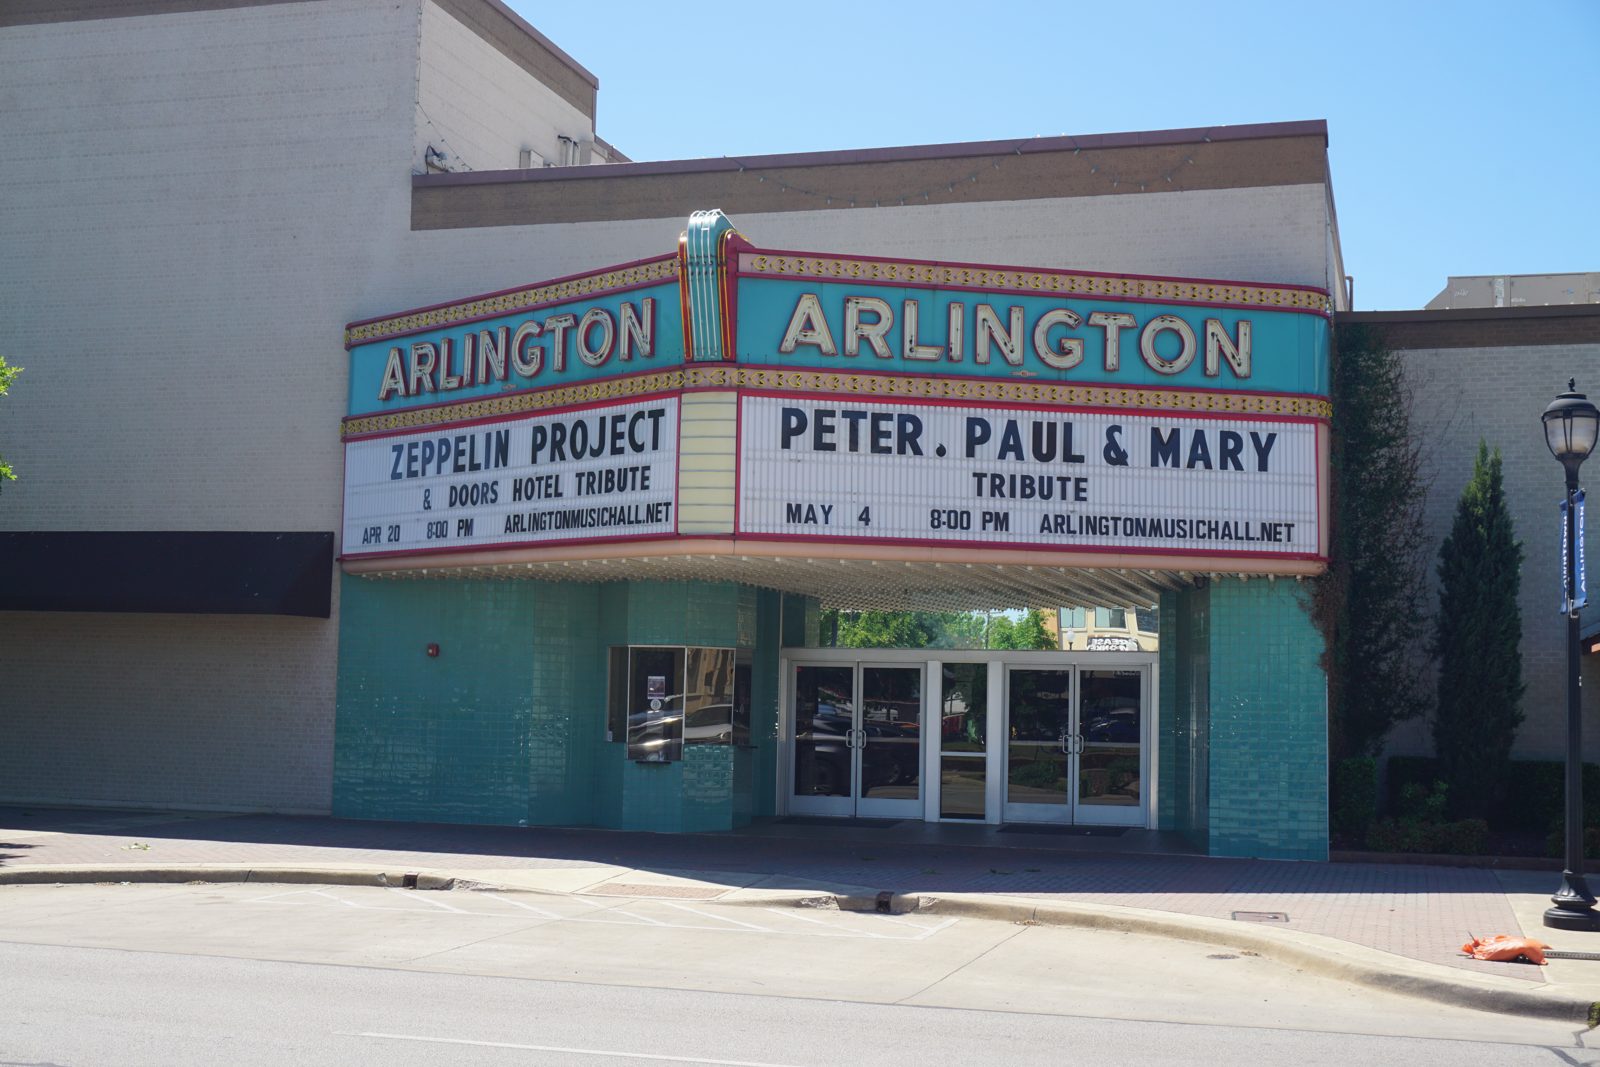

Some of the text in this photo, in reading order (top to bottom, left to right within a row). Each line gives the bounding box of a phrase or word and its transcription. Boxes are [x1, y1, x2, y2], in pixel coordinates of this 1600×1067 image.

[378, 297, 656, 400] ARLINGTON
[778, 293, 1252, 379] ARLINGTON
[390, 409, 665, 480] ZEPPELIN PROJECT
[965, 416, 1085, 463] PAUL
[1103, 424, 1129, 467] &
[1150, 427, 1278, 472] MARY
[423, 465, 651, 510] & DOORS HOTEL TRIBUTE
[972, 472, 1088, 501] TRIBUTE
[362, 501, 672, 545] APR 20 8:00 PM ARLINGTONMUSICHALL.NET
[786, 502, 1295, 543] MAY 4 8:00 PM ARLINGTONMUSICHALL.NET
